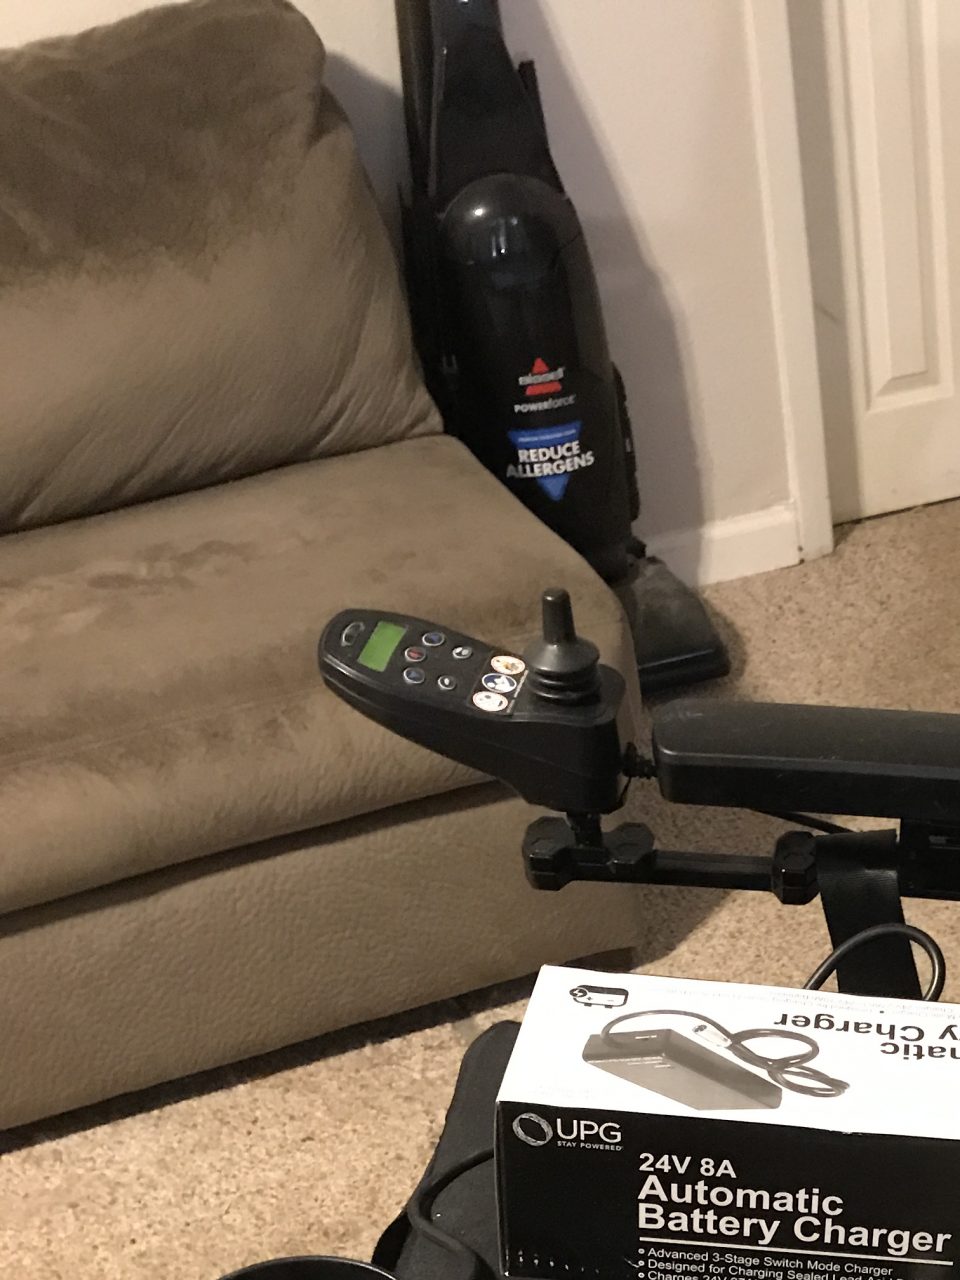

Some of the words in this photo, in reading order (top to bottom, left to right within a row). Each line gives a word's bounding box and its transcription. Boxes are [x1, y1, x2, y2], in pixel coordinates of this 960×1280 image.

[506, 451, 595, 479] ALLERGENS
[518, 440, 580, 463] REDUCE
[774, 1013, 925, 1042] Charger
[556, 1118, 622, 1143] UPG
[557, 1140, 577, 1148] STAY
[580, 1142, 622, 1151] POWERED
[639, 1152, 691, 1174] 24V
[700, 1158, 737, 1178] 8A
[637, 1174, 844, 1216] Automatic
[638, 1203, 781, 1245] Battery
[793, 1216, 952, 1255] Charger
[648, 1248, 709, 1262] Advanced
[712, 1253, 760, 1266] 3-Stage
[764, 1256, 803, 1269] Switch
[807, 1260, 841, 1272] Mode
[844, 1263, 893, 1276] Charger
[648, 1259, 705, 1273] Designed
[708, 1264, 726, 1274] for
[728, 1266, 783, 1280] Charging
